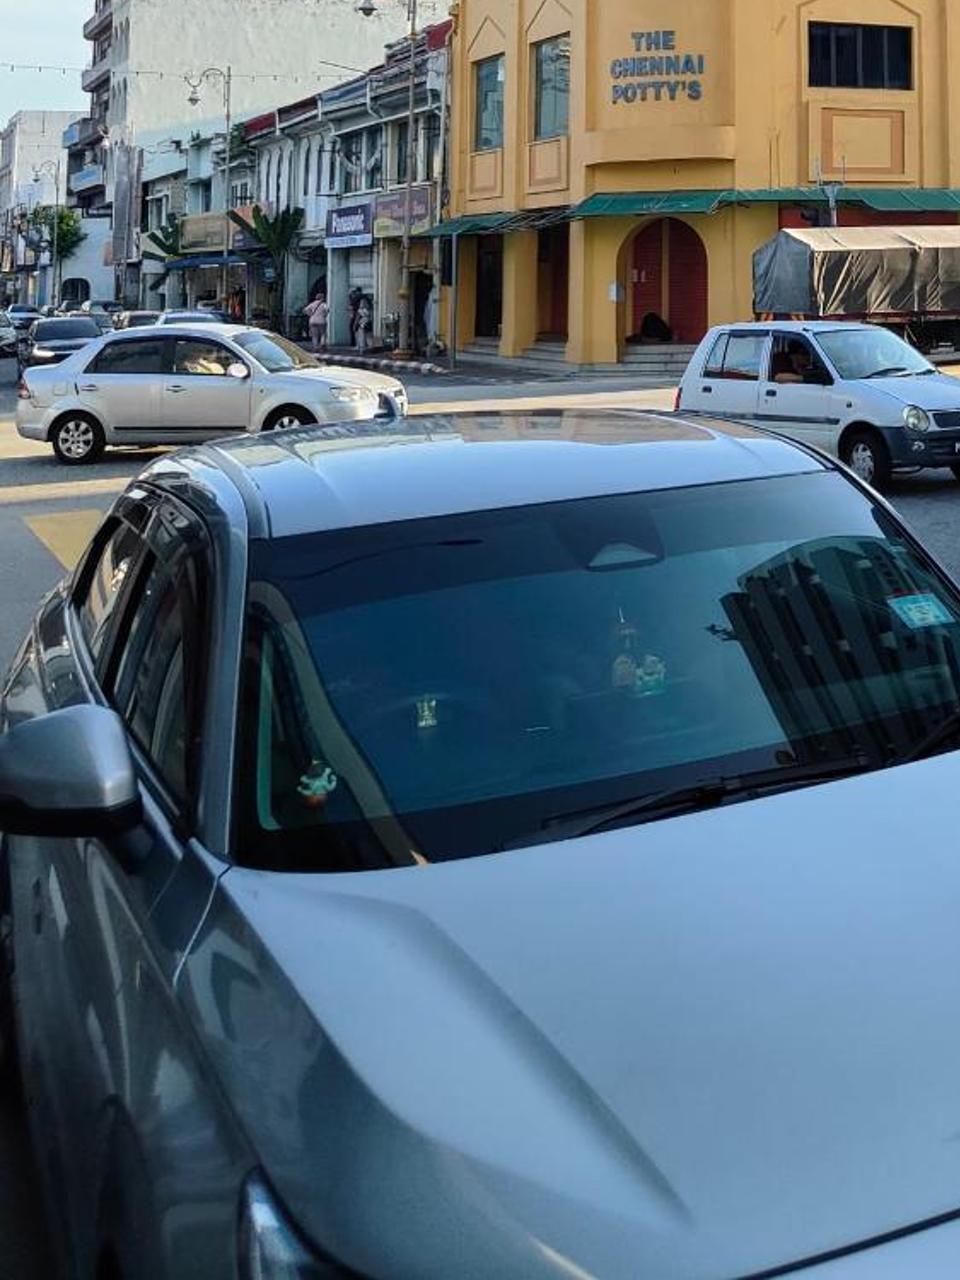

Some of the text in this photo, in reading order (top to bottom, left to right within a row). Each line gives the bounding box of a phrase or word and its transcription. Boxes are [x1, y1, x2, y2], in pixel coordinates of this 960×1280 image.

[631, 30, 676, 51] THE
[610, 54, 704, 79] CHENNAI
[612, 80, 702, 104] POTTY'S
